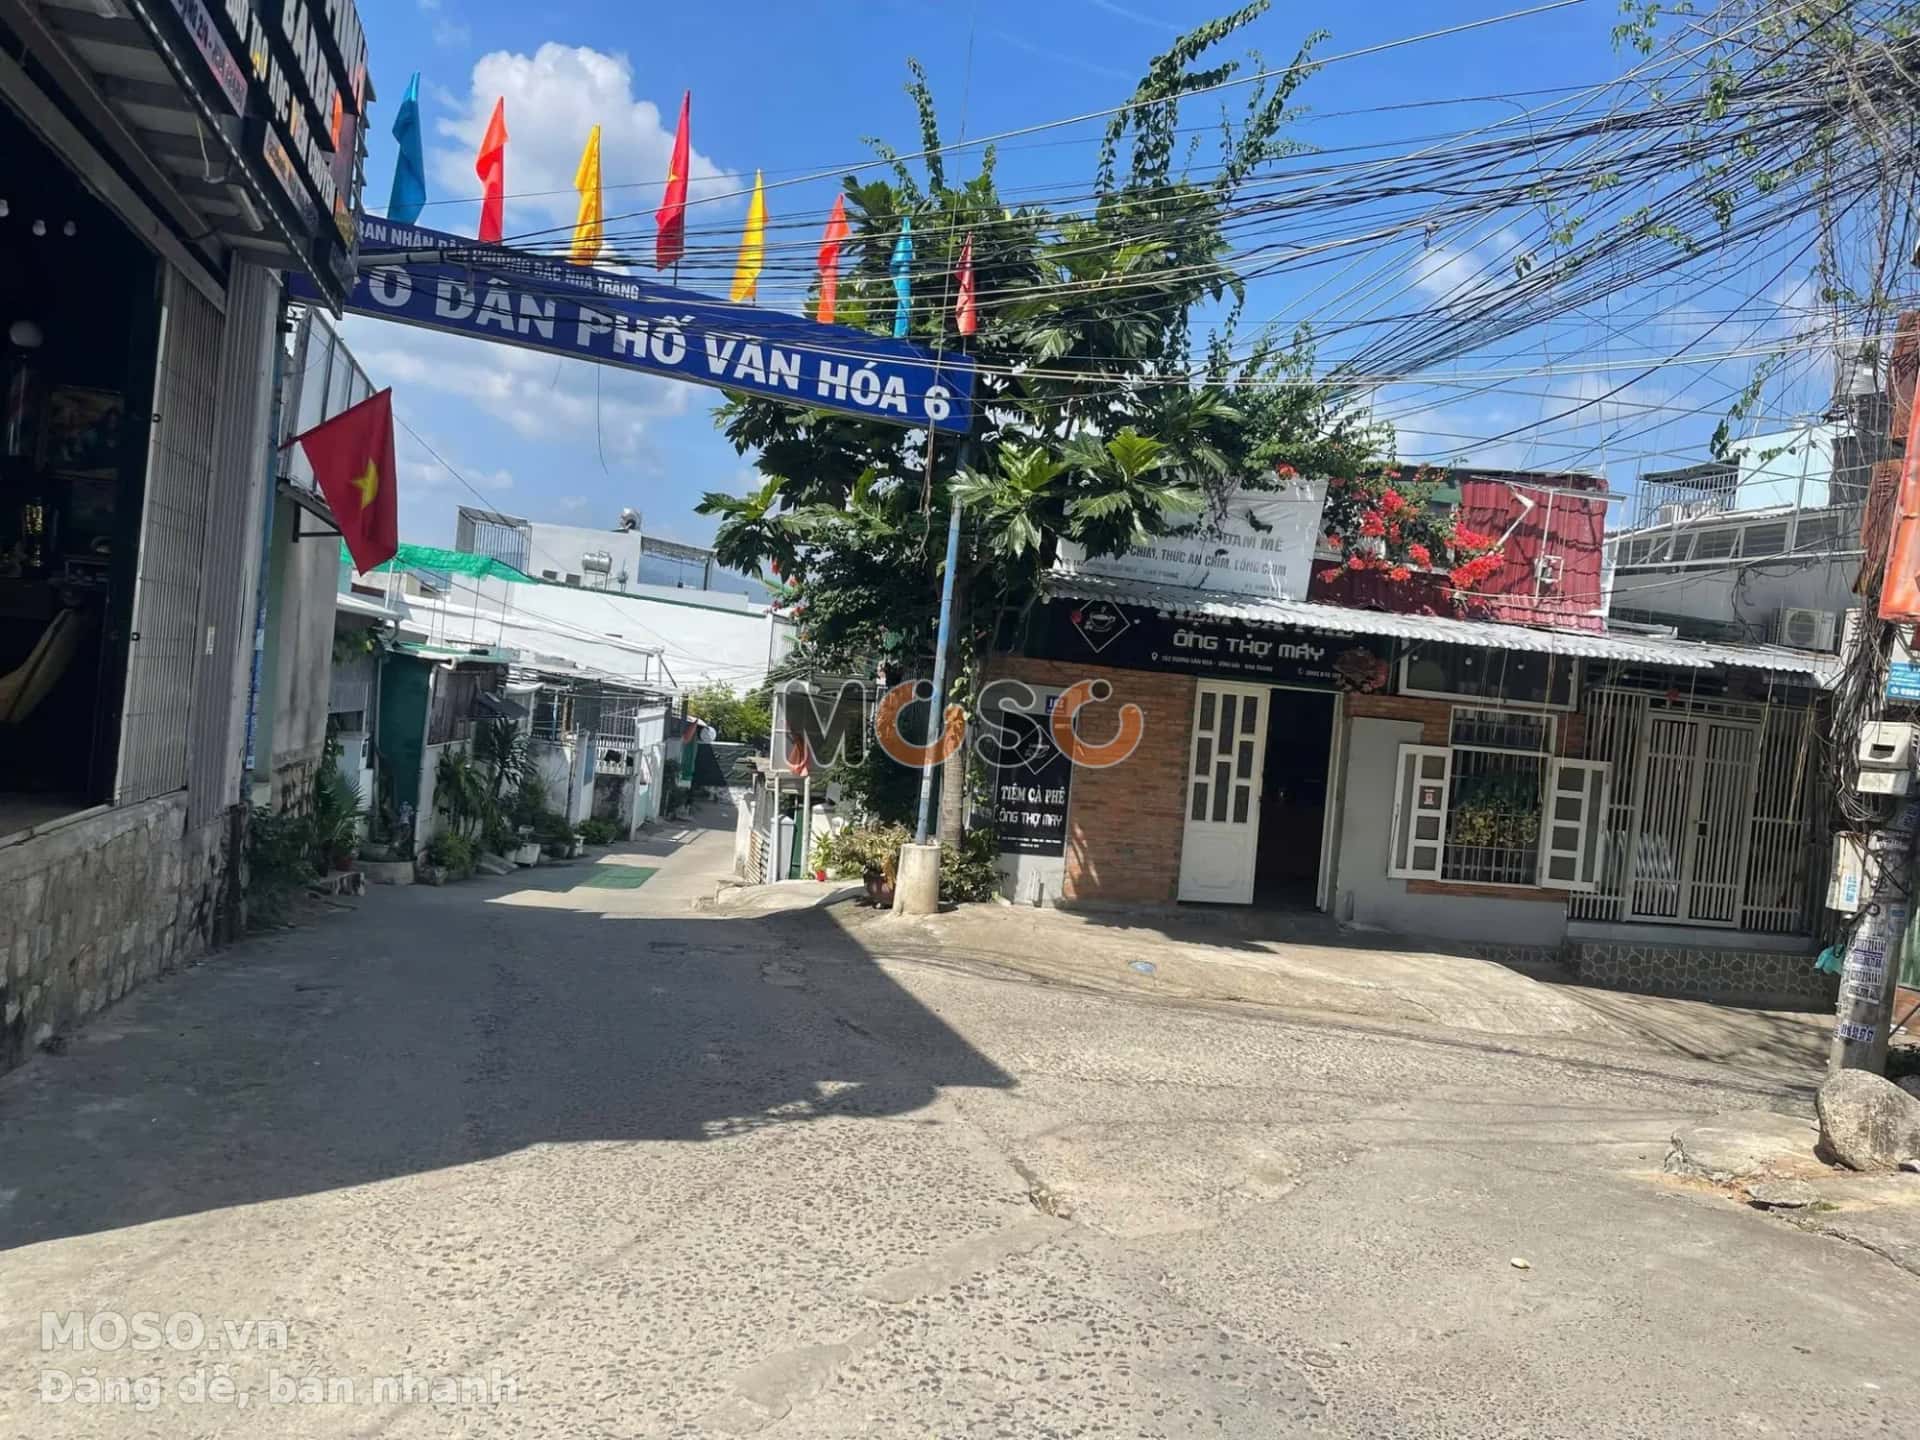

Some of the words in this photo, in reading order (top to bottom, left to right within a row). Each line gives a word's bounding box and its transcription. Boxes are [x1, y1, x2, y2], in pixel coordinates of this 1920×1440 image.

[391, 228, 434, 248] NHÂN
[597, 276, 640, 300] TRANG
[435, 276, 556, 340] DÂN
[576, 306, 697, 366] PHỐ
[817, 361, 908, 414] HÓA
[923, 385, 951, 421] 6
[1173, 629, 1218, 650] ÔNG
[1000, 782, 1026, 804] TIỆM
[1045, 786, 1066, 804] PHÊ
